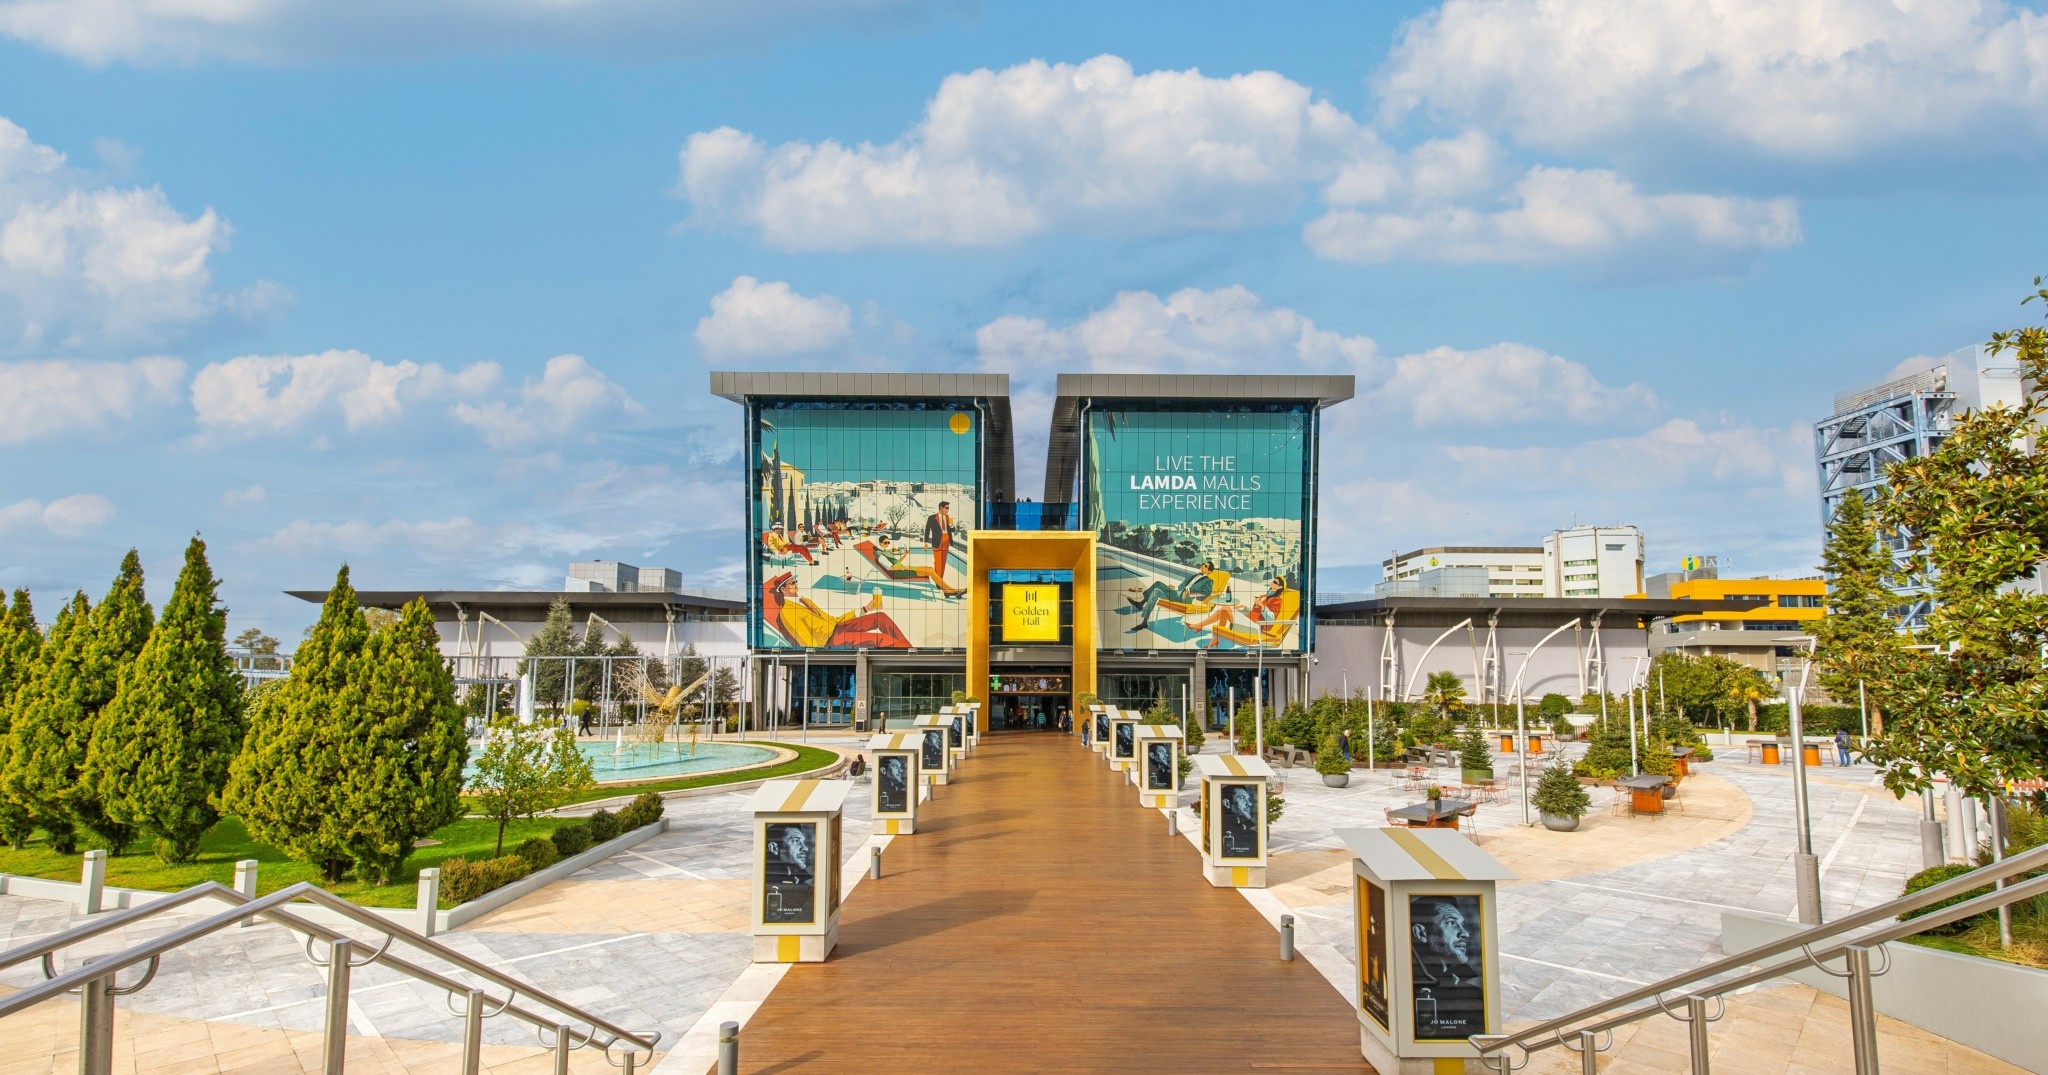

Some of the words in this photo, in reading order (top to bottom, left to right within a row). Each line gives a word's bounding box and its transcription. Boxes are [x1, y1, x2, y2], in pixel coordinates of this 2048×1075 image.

[1156, 456, 1193, 471] LIVE
[1200, 455, 1236, 471] THE
[1130, 475, 1197, 490] LAMDA
[1203, 475, 1261, 491] MALLS
[1140, 494, 1251, 510] EXPERIENCE
[1013, 606, 1049, 615] Golden
[1022, 617, 1040, 625] Hall
